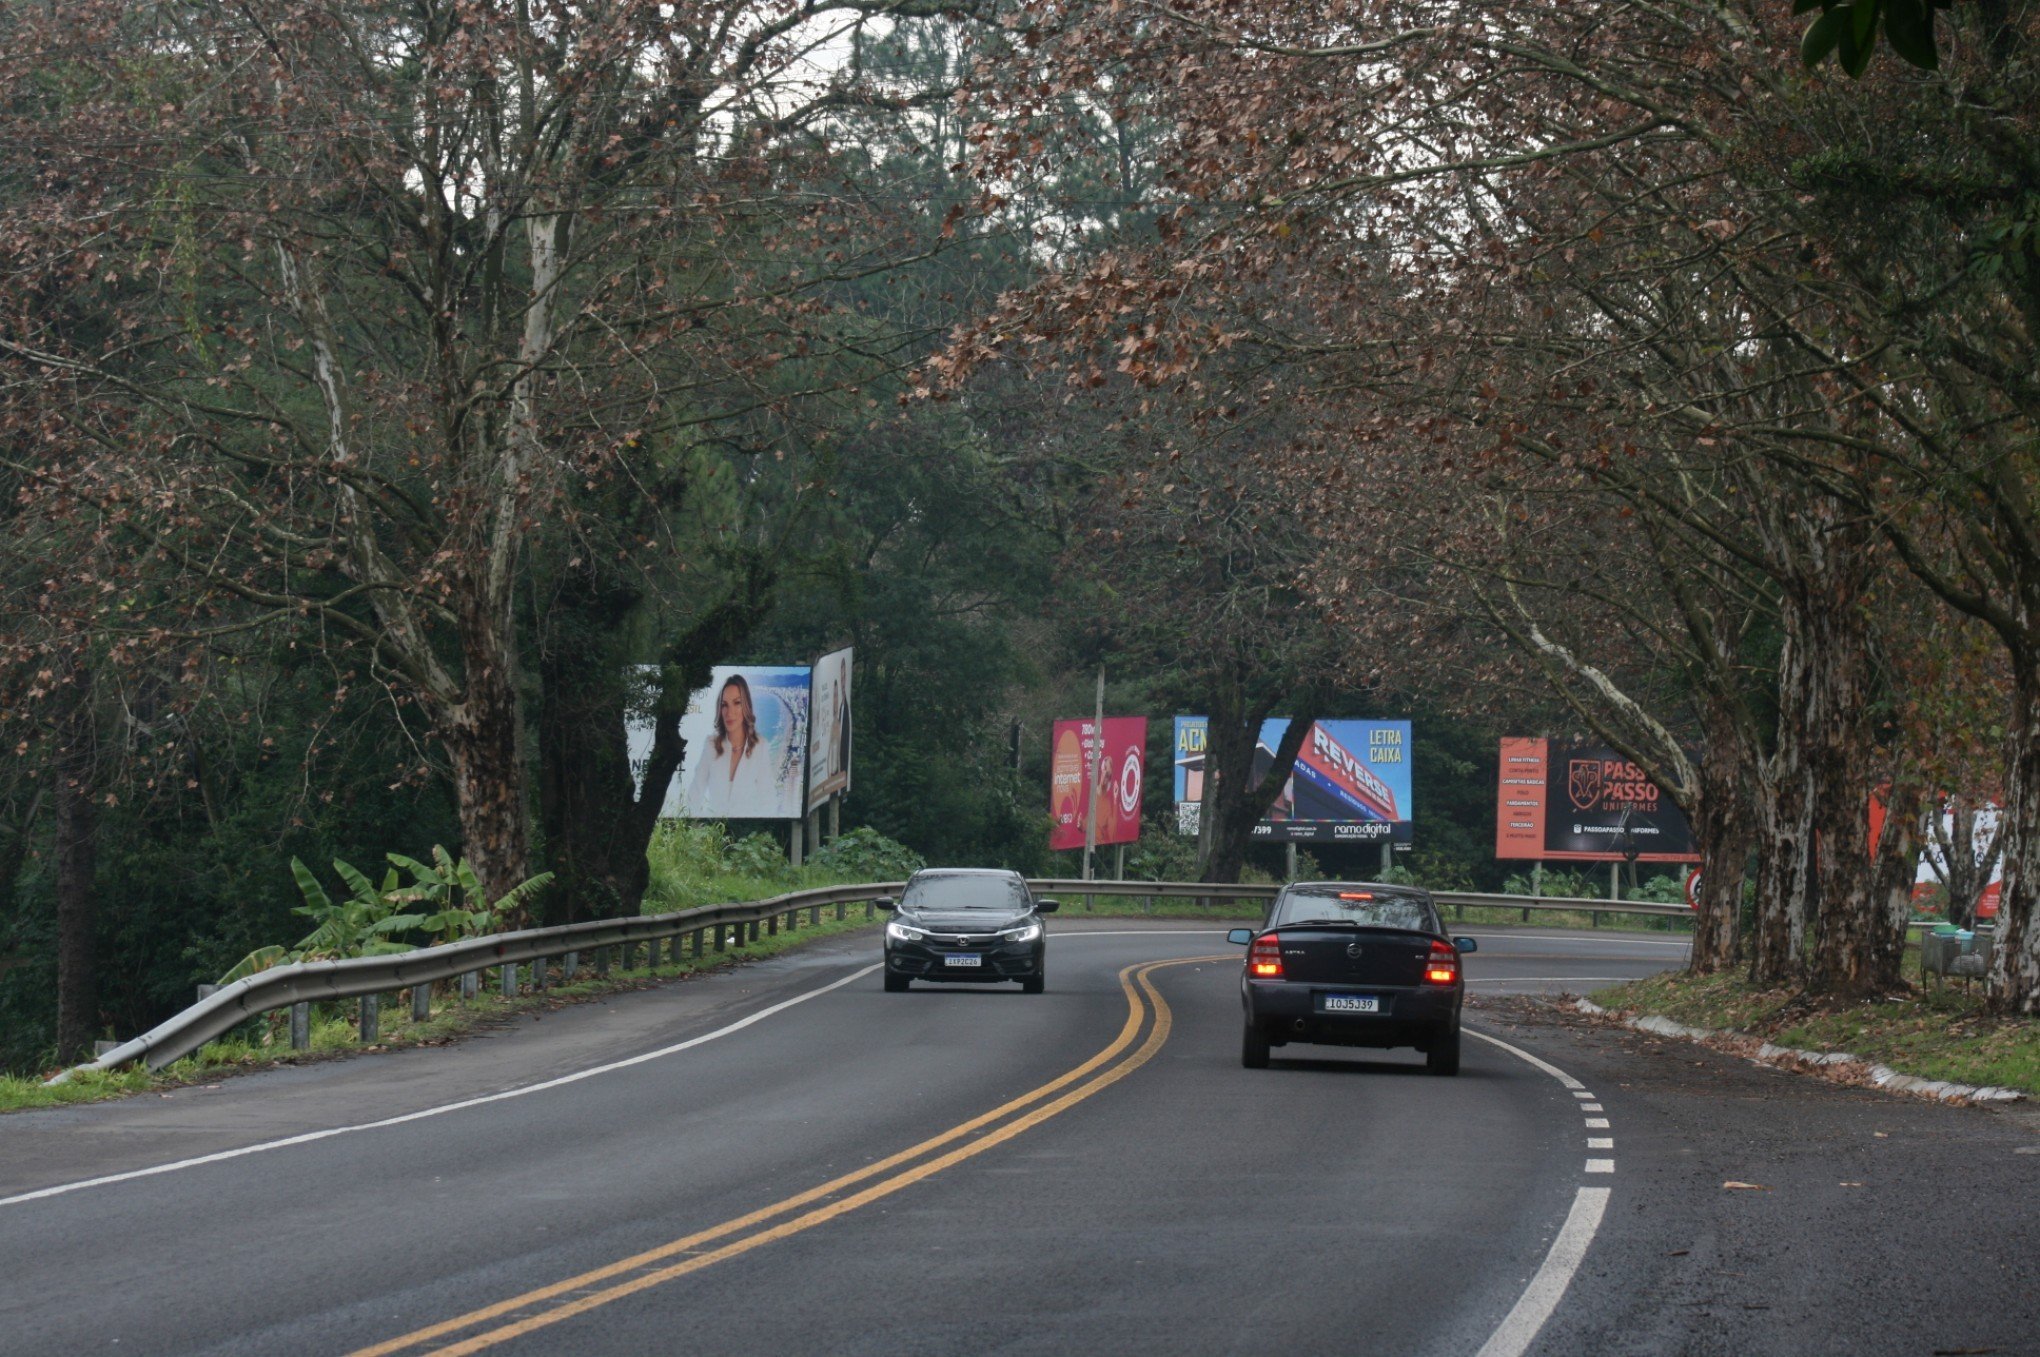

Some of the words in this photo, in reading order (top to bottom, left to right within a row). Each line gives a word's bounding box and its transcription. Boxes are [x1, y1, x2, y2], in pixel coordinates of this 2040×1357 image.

[1370, 729, 1402, 745] LETRA
[1314, 726, 1391, 804] REVERSE
[1370, 747, 1401, 763] CAIXA
[1604, 761, 1646, 781] PASS
[1603, 781, 1659, 802] PASSO
